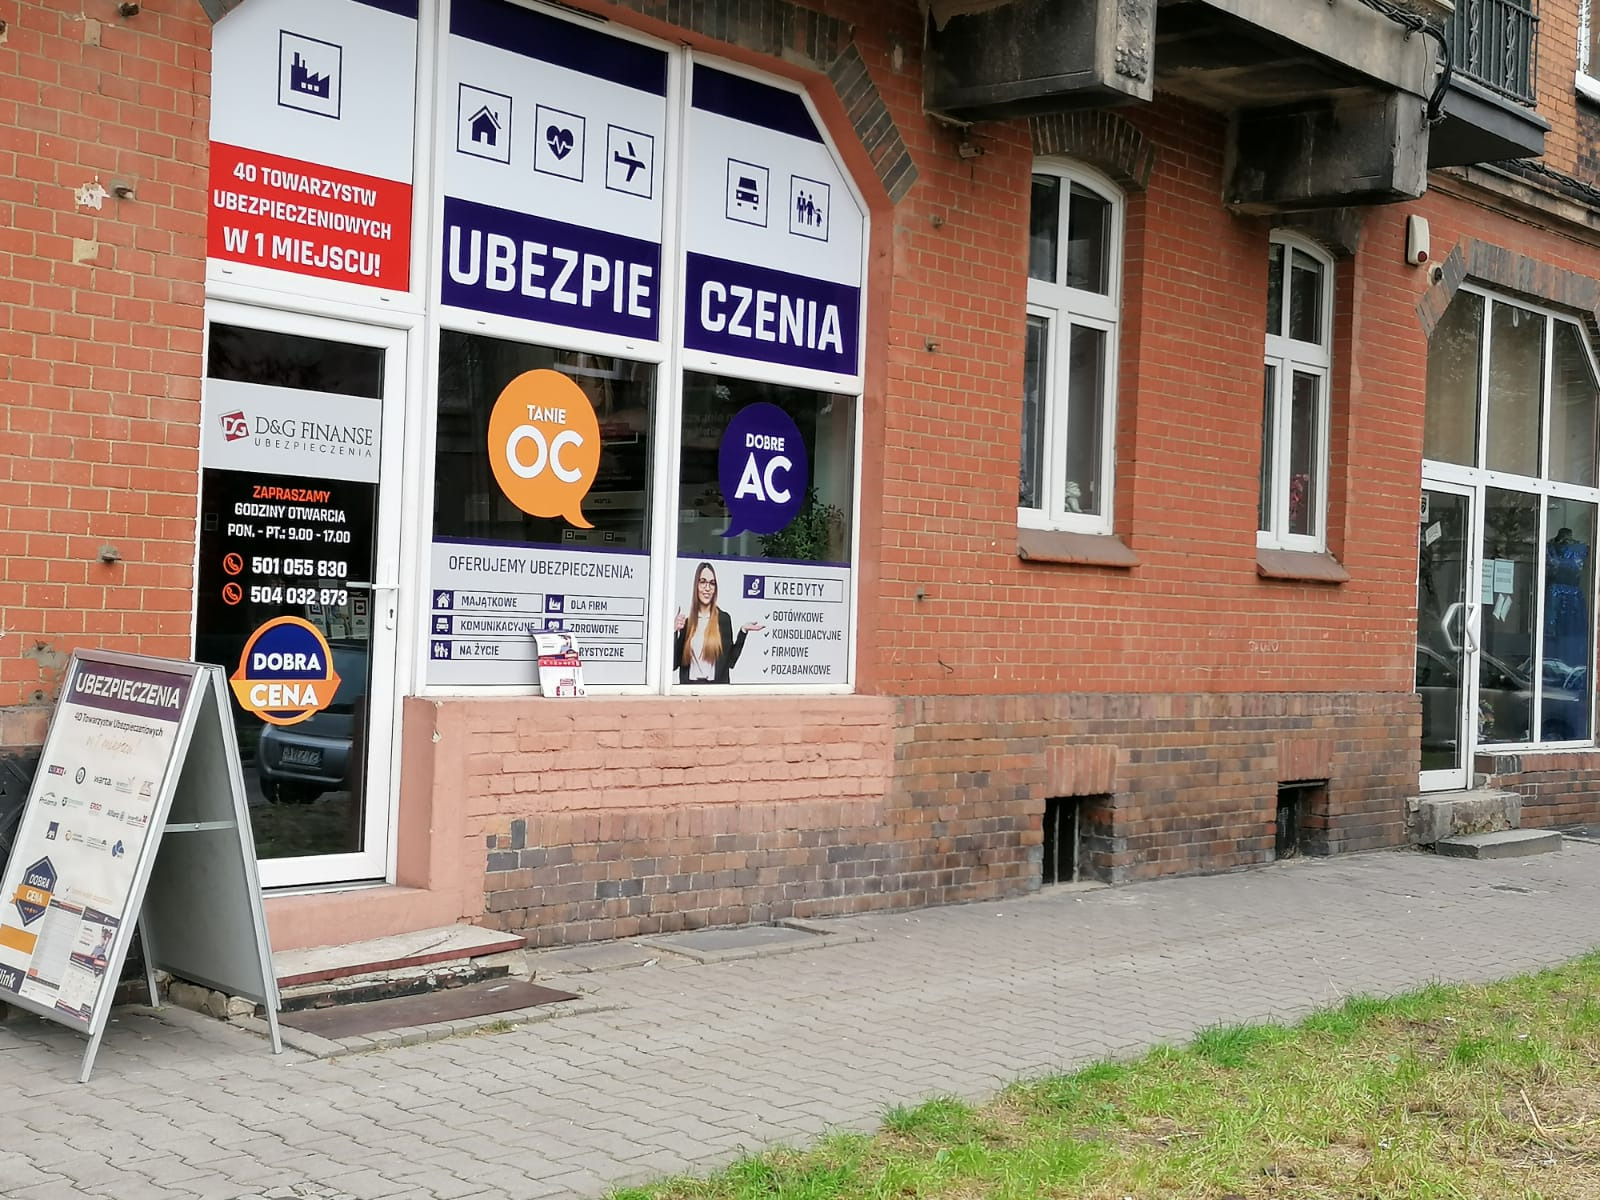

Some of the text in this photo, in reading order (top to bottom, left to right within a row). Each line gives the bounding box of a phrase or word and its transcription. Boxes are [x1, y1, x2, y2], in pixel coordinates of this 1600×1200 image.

[233, 162, 376, 207] 40 TOWARZYSTW
[213, 189, 391, 240] UBEZPIECZENIOWYCH
[223, 226, 380, 277] W 1 MIEJSCU!
[448, 225, 843, 354] UBEZPIE CZENIA
[526, 404, 567, 424] TANIE
[255, 416, 373, 446] D&G FINANSE
[254, 438, 372, 457] UBEZPIECZENIA
[745, 433, 785, 452] DOBRE
[505, 424, 584, 483] OC
[734, 452, 792, 504] AC
[252, 485, 331, 503] ZAPRASZAMY
[234, 502, 346, 523] GODZINY OTWARCIA
[227, 523, 255, 538] PON.
[288, 527, 313, 541] 9.00
[324, 530, 351, 543] 17.00
[251, 556, 347, 578] 501 055 830
[449, 555, 634, 579] OFERUJEMY UBEZPIECZNENIA:
[250, 586, 348, 606] 504 032 873
[773, 581, 825, 597] KREDYTY
[461, 595, 517, 608] MAJĄTKOWE
[571, 600, 607, 611] DLA FIRM
[460, 620, 535, 632] KOMUNIKACYJNE
[773, 610, 824, 623] GOTÓWKOWE
[570, 623, 619, 634] ZDROWOTNE
[772, 628, 841, 641] KONSOLIDACYJNE
[459, 642, 499, 656] NA ŻYCIE
[579, 647, 624, 657] RYSTYCZNE
[771, 646, 809, 658] FIRMOWE
[253, 653, 321, 671] DOBRA
[771, 664, 831, 675] POZABANKOWE
[75, 672, 180, 709] UBEZPIECZENIA
[250, 683, 319, 707] CENA
[29, 873, 50, 889] DOBRA
[0, 968, 16, 988] link
